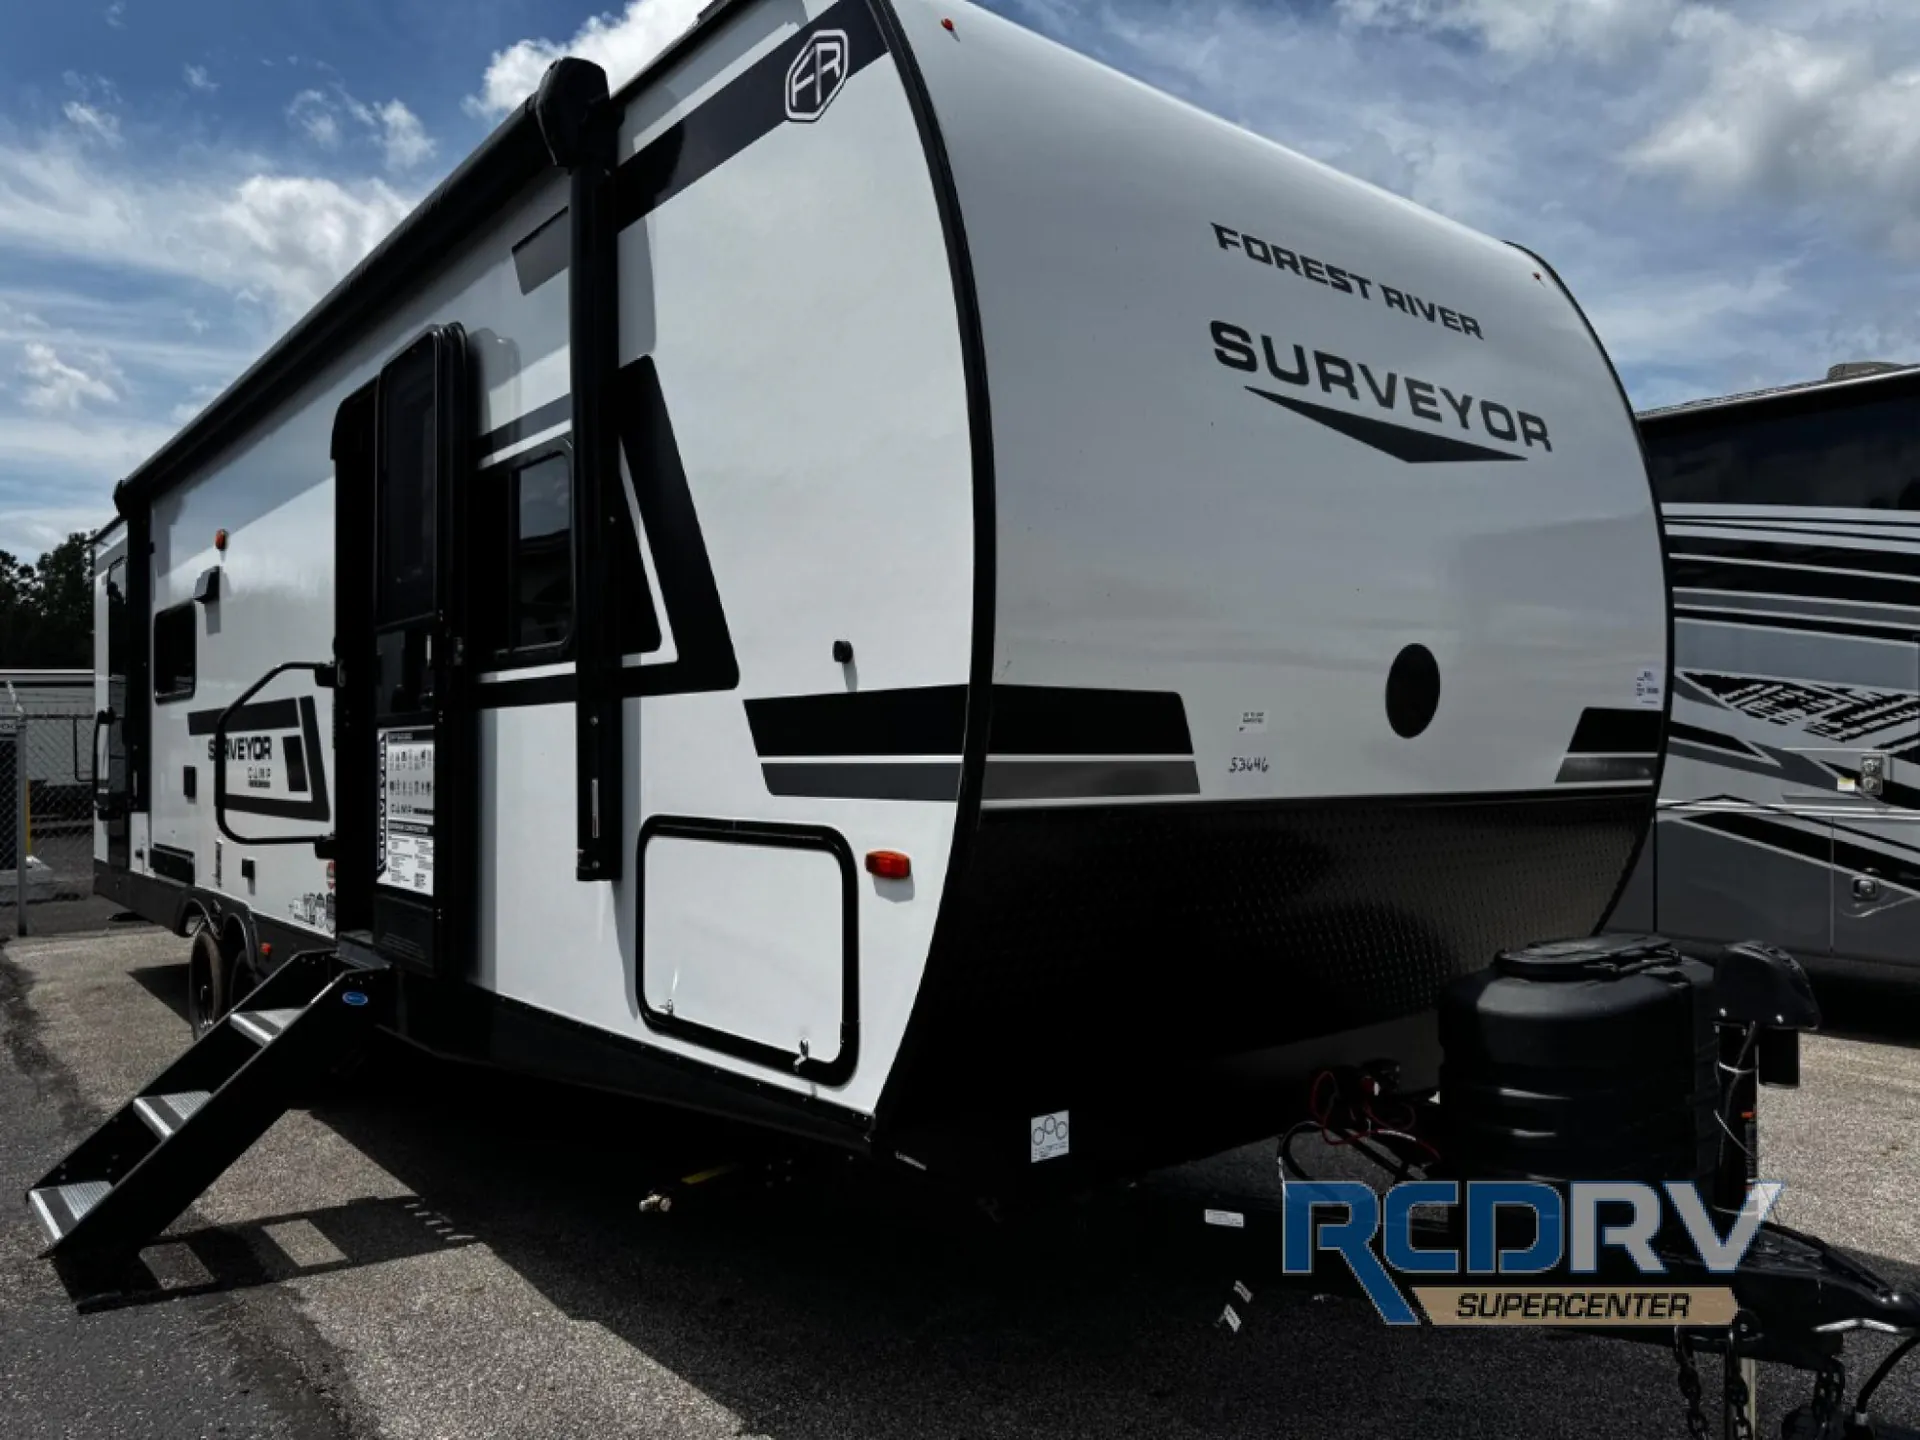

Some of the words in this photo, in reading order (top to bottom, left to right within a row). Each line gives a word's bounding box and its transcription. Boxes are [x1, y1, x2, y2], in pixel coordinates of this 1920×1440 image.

[1210, 222, 1371, 299] FOREST
[1379, 284, 1484, 340] RIVER
[1209, 320, 1552, 452] SURVEYOR
[1228, 756, 1270, 774] 53646
